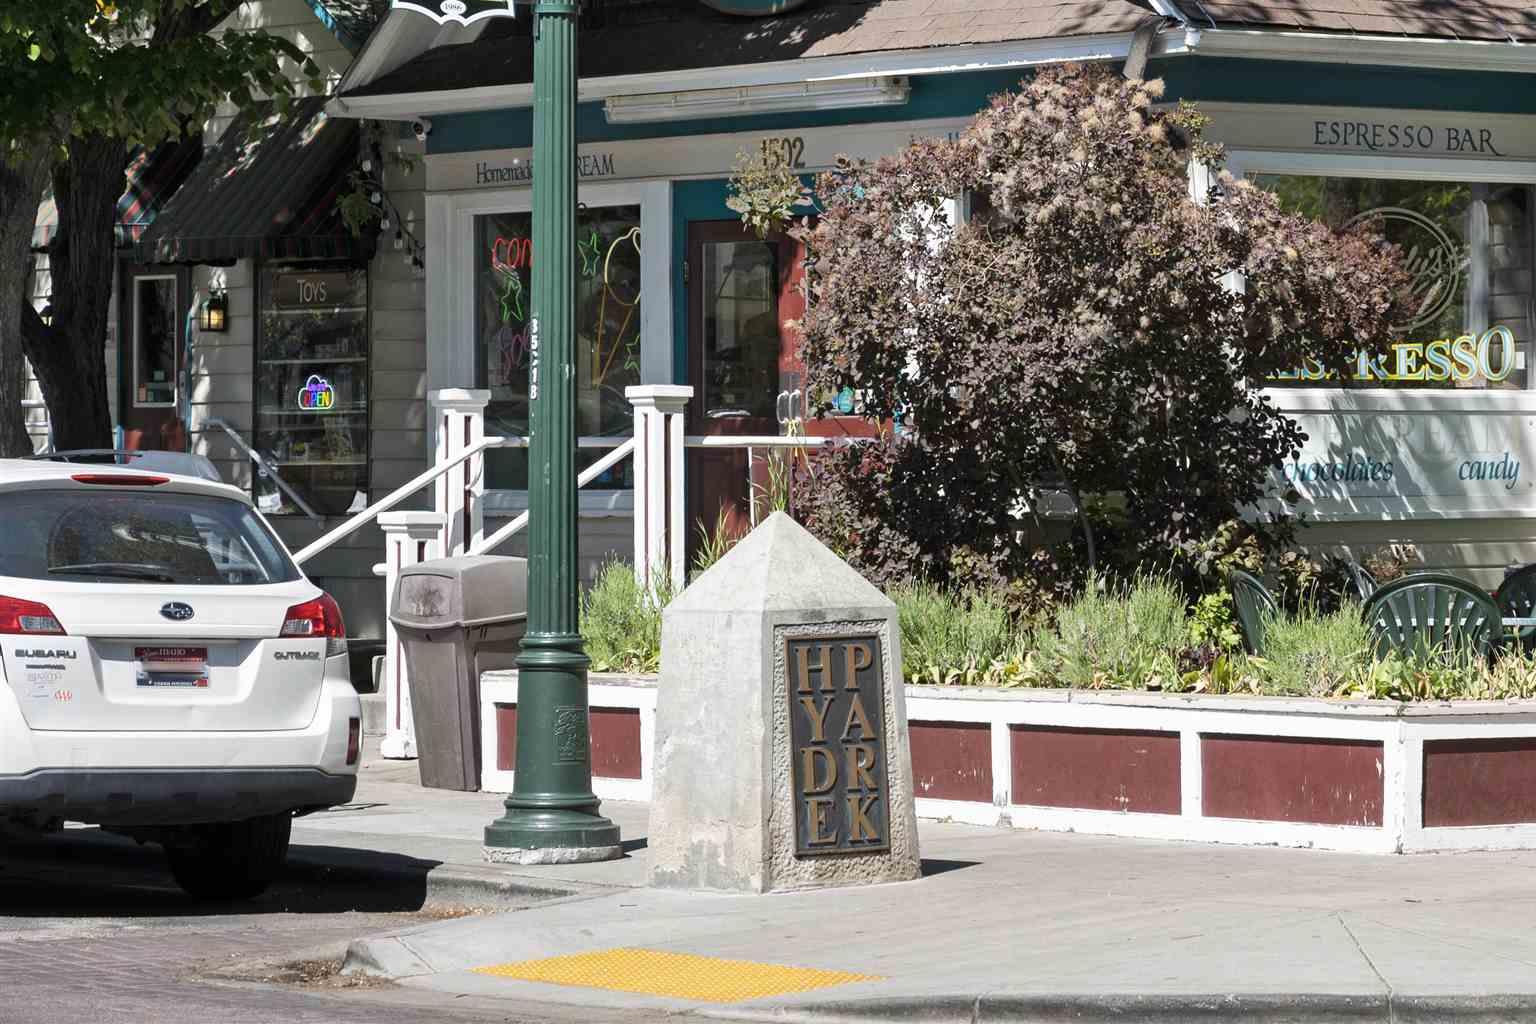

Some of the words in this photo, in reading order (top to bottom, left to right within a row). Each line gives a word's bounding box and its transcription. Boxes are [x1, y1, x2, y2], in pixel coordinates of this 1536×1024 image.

[762, 137, 806, 169] 1502
[1313, 121, 1434, 151] ESPRESSO
[1445, 127, 1507, 157] BAR
[475, 159, 534, 185] Homemad
[576, 153, 617, 177] REAM
[296, 279, 328, 303] TOYS
[303, 390, 331, 408] OPEN
[1281, 453, 1394, 482] chocolates
[1458, 451, 1521, 490] candy
[15, 649, 77, 660] SUBARU
[794, 644, 840, 848] HYDE
[839, 641, 882, 843] PARK
